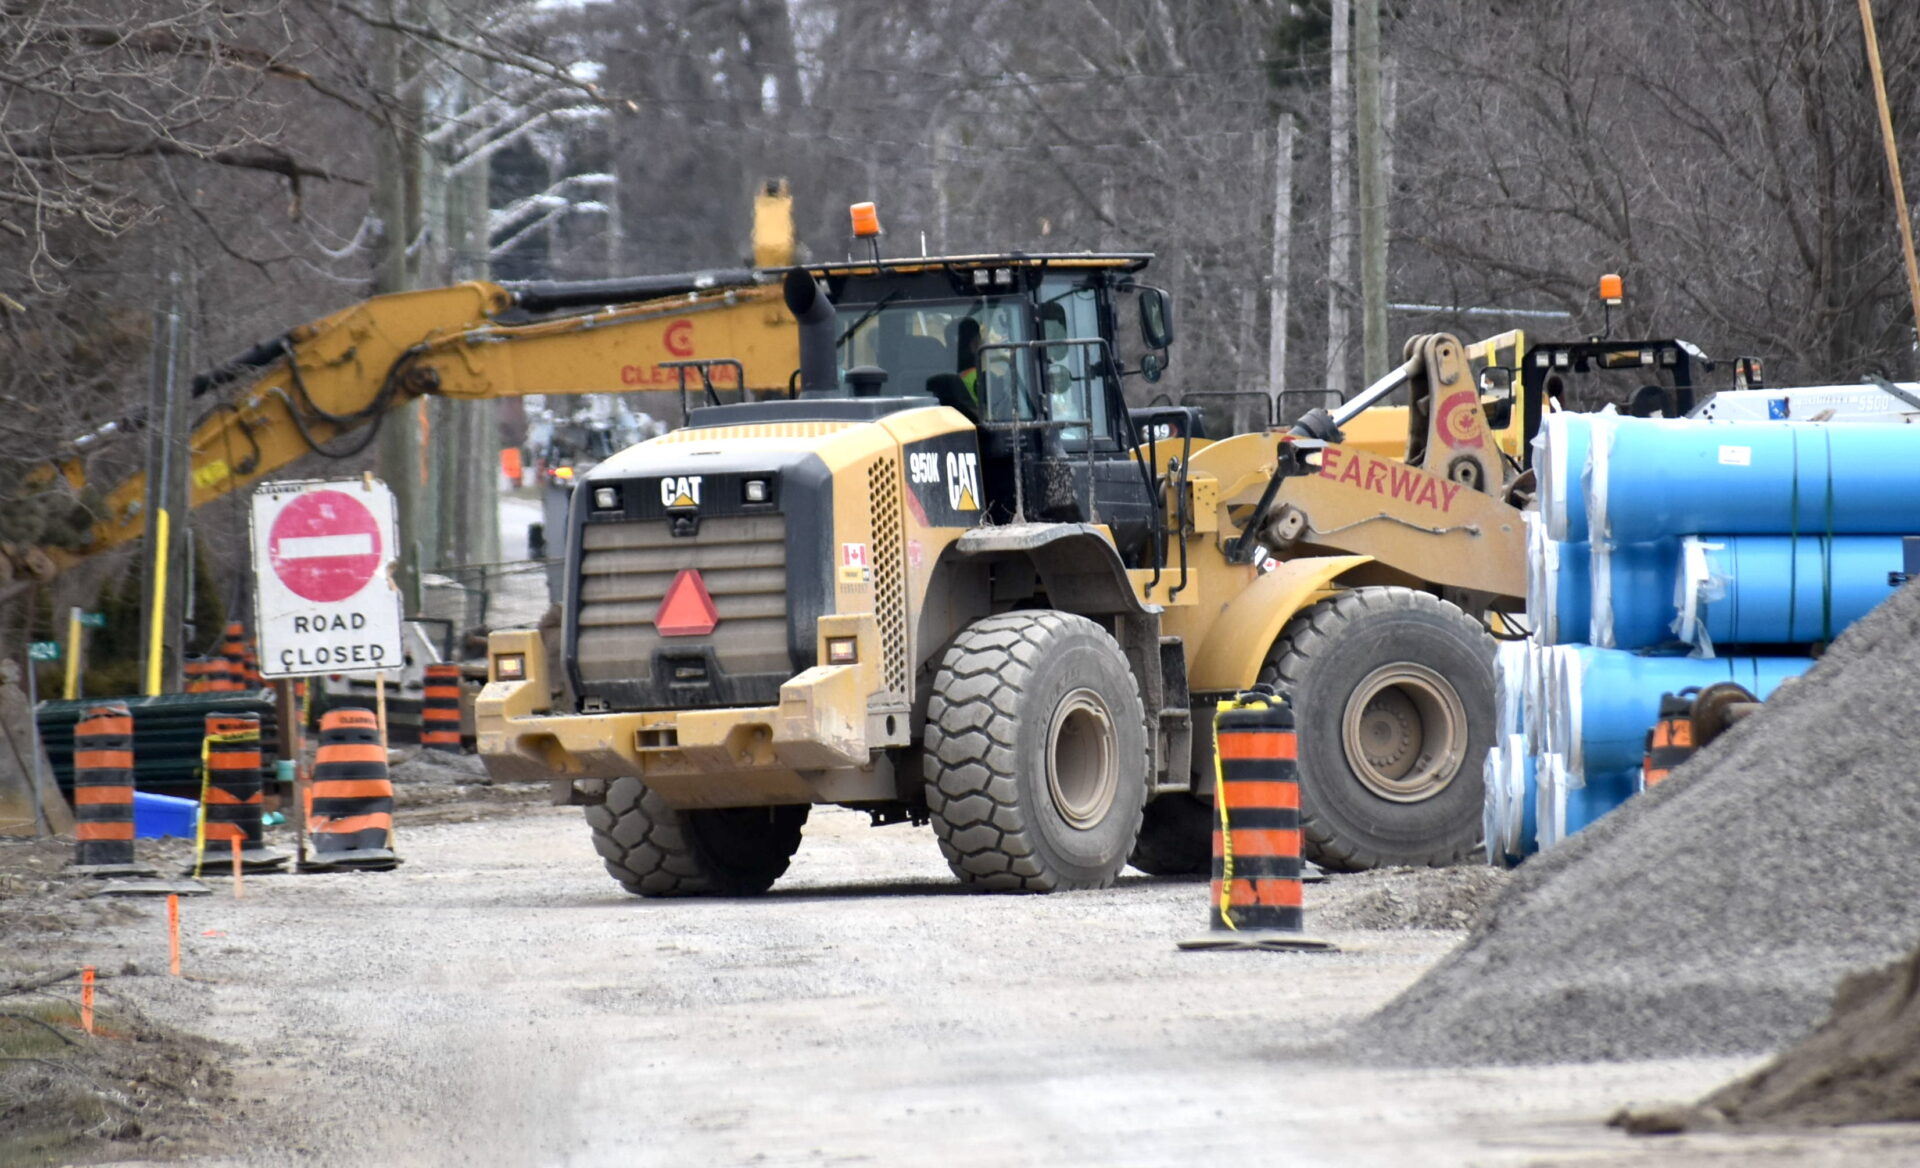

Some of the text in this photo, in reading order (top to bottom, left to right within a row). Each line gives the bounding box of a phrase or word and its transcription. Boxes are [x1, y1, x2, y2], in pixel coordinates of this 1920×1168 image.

[910, 451, 980, 511] 950K CAT
[1281, 436, 1461, 512] EARWAY
[661, 476, 702, 507] CAT
[294, 612, 366, 634] ROAD
[280, 643, 385, 667] CLOSED
